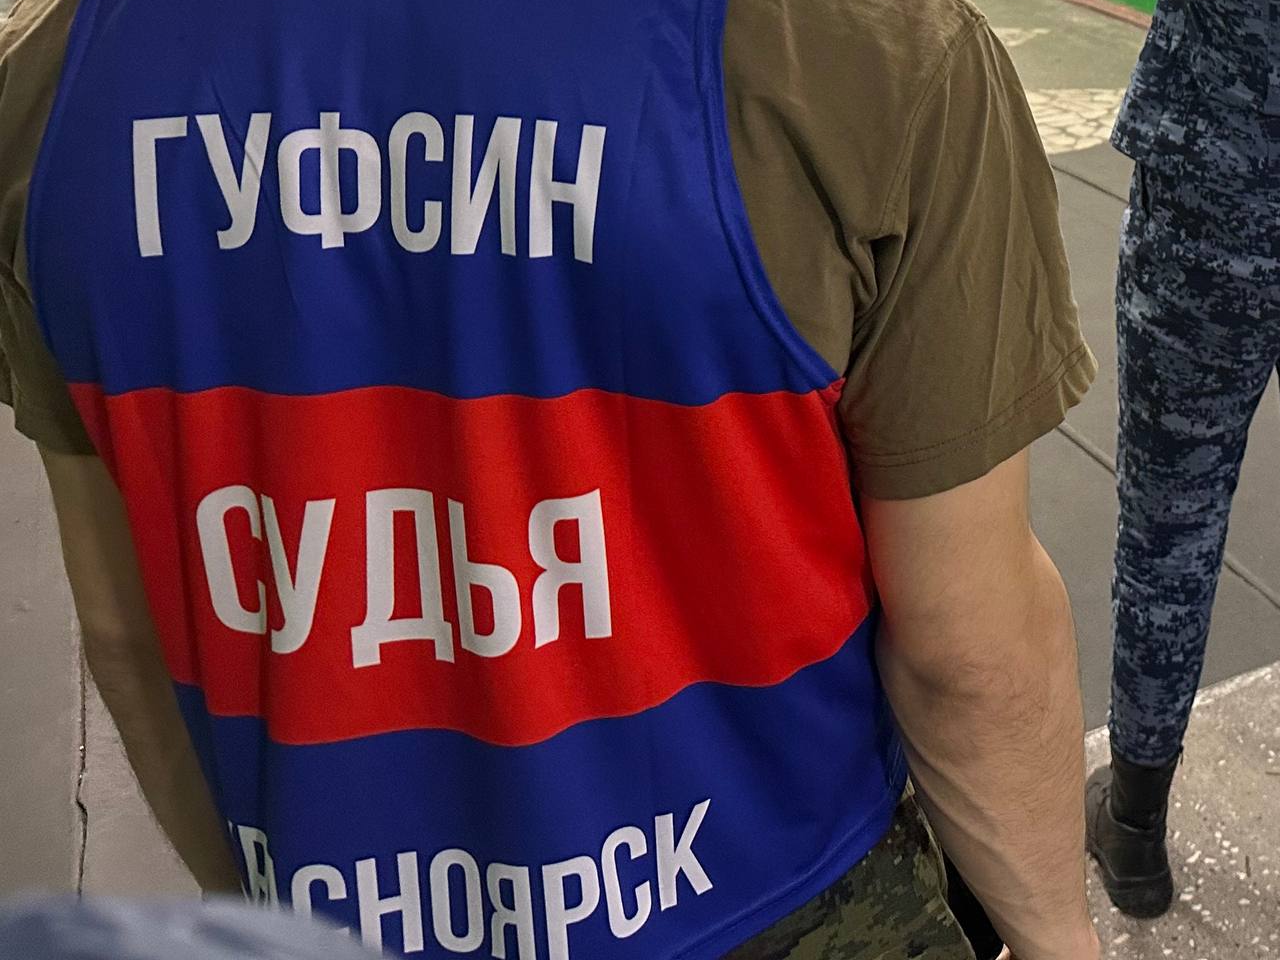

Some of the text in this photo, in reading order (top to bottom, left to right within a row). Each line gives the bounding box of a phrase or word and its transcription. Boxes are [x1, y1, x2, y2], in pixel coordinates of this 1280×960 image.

[132, 111, 607, 264] ГУФСИН
[195, 484, 613, 669] СУДЬЯ
[227, 798, 714, 960] РСНОЯРСК
